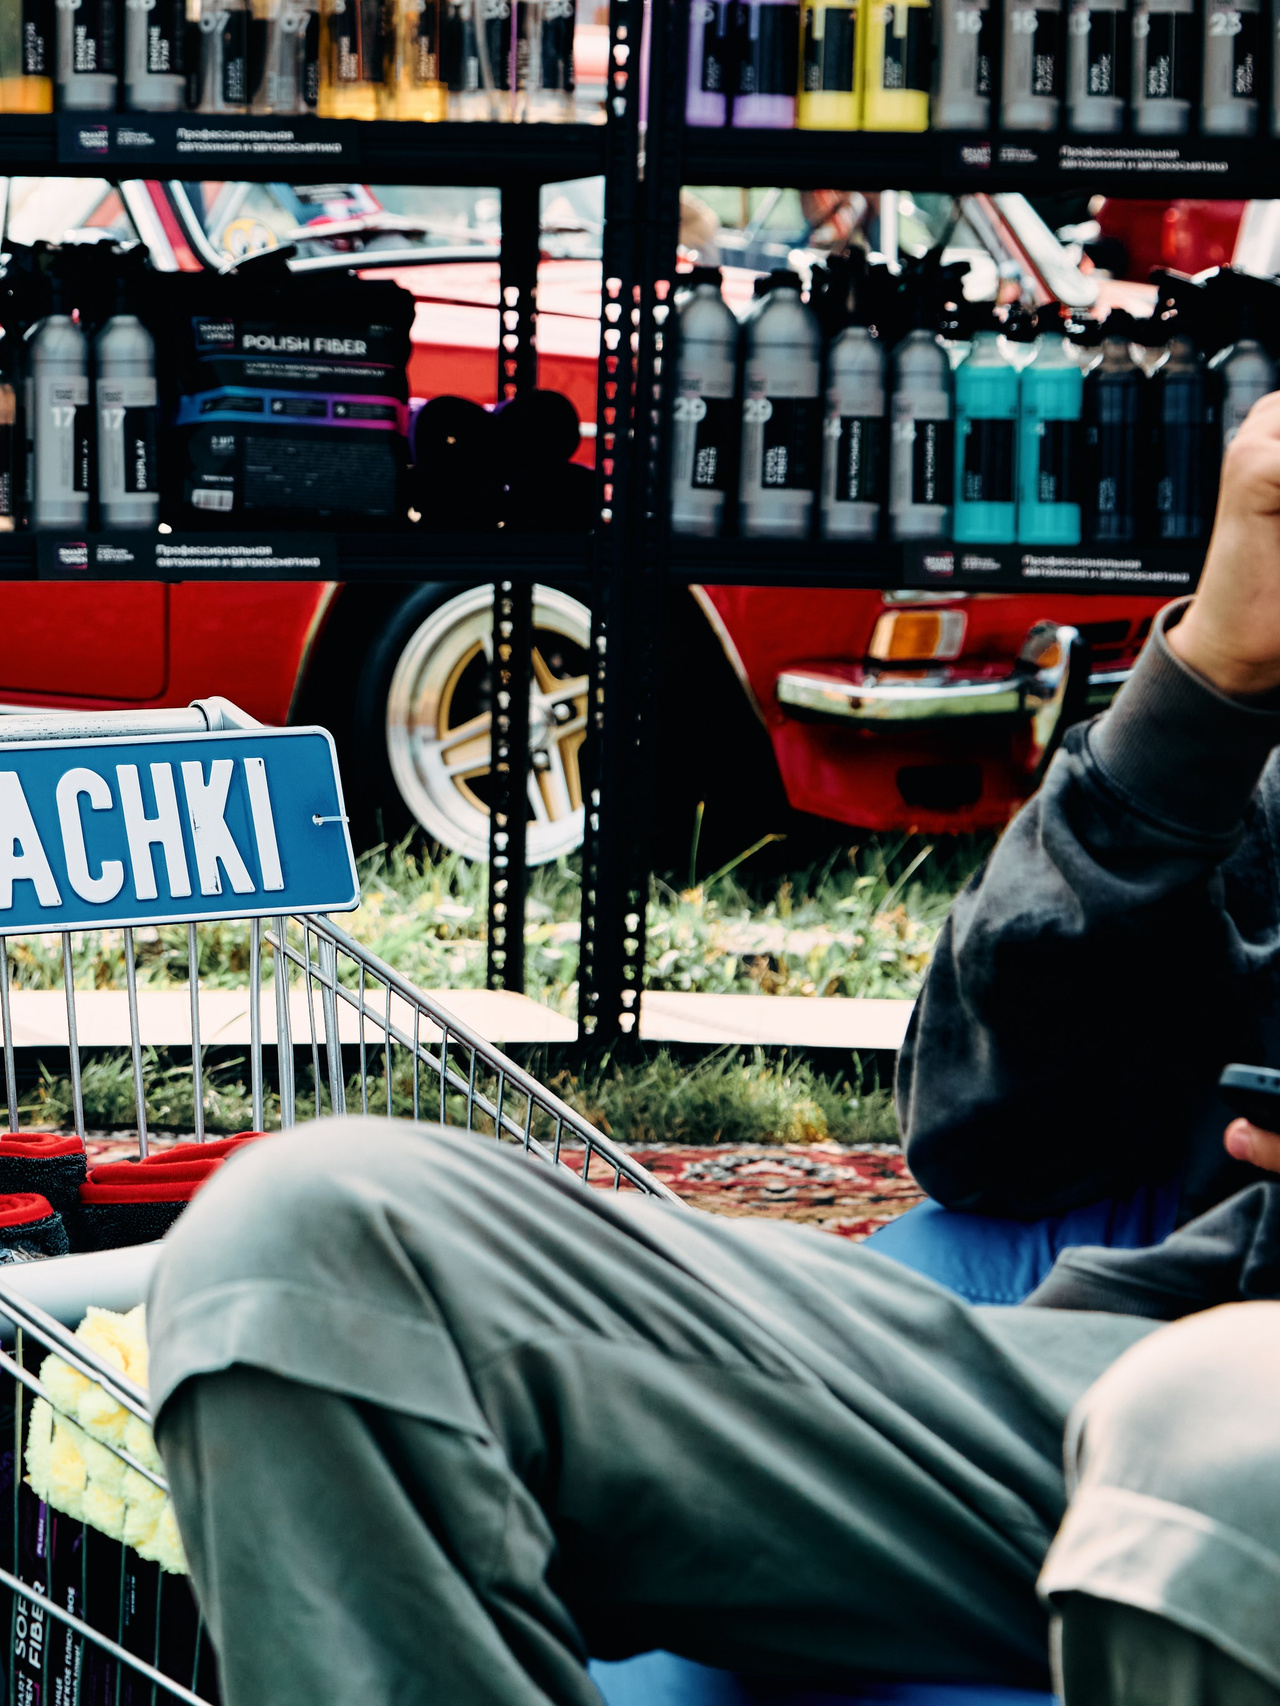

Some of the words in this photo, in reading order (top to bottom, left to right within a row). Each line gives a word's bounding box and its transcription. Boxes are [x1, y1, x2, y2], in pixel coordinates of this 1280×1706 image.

[955, 10, 982, 34] 16
[1012, 10, 1038, 34] 16
[243, 334, 310, 351] POLISH
[314, 337, 367, 355] FIBER
[51, 406, 76, 428] 17
[102, 408, 126, 430] 17
